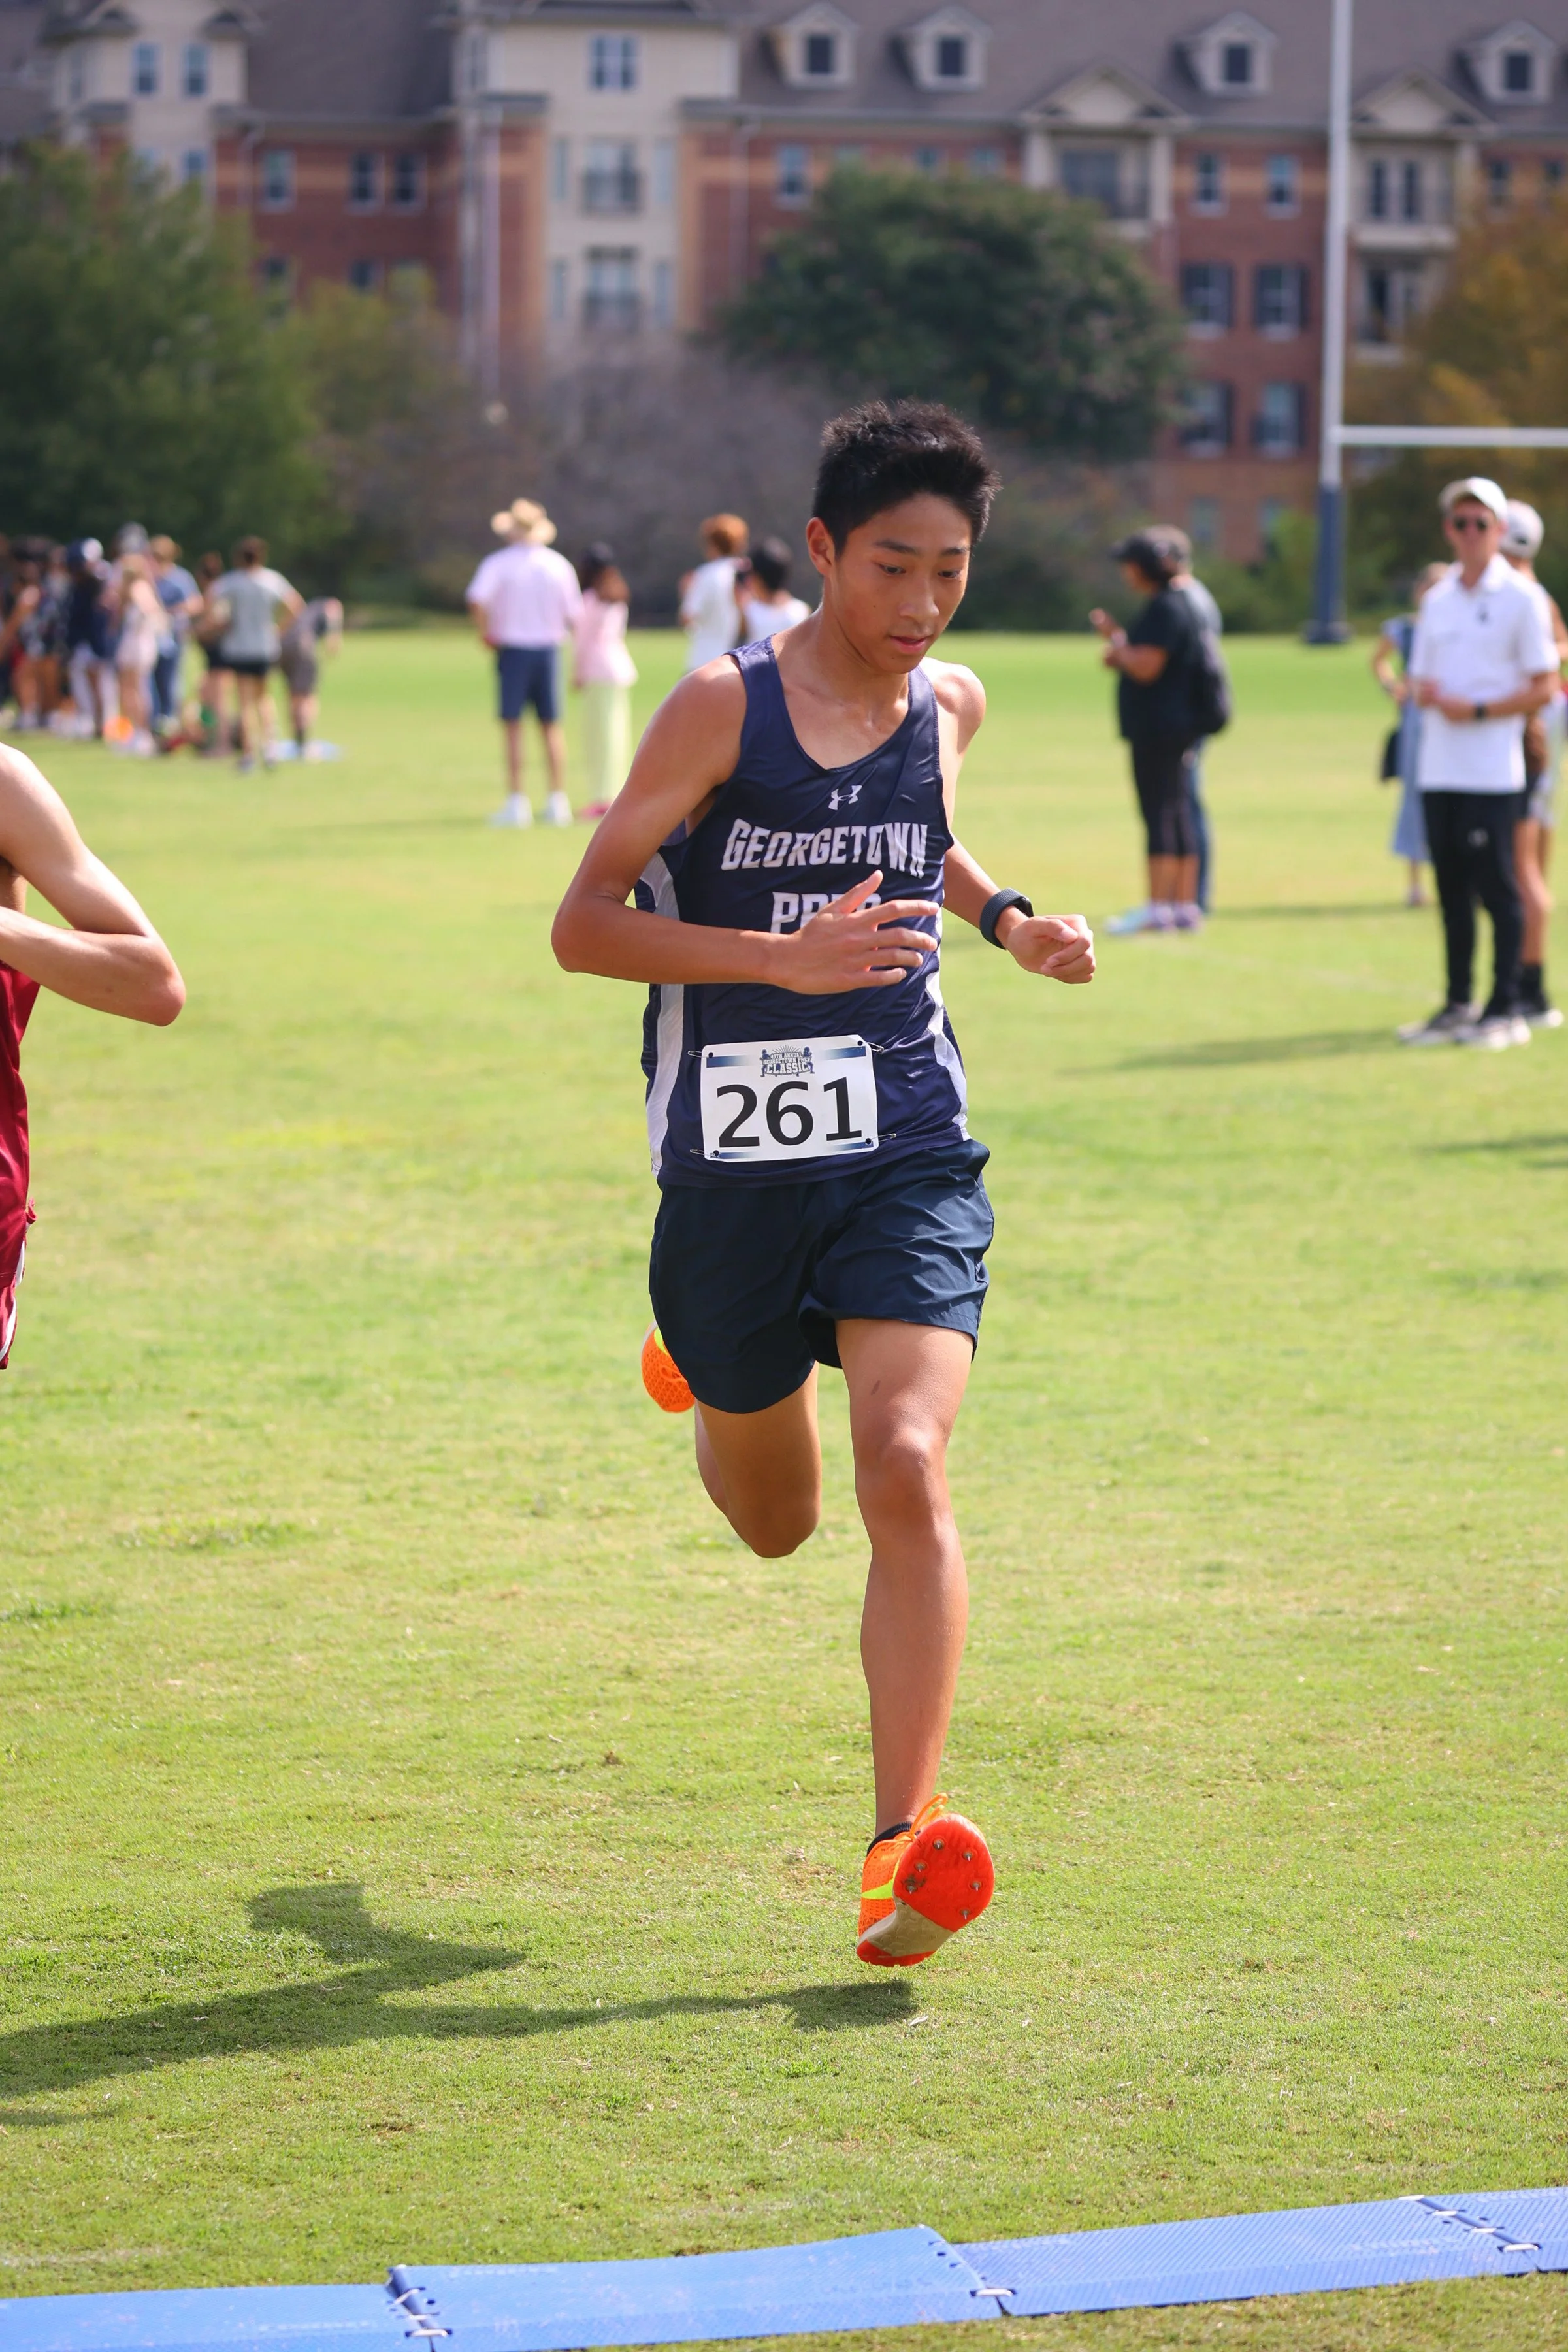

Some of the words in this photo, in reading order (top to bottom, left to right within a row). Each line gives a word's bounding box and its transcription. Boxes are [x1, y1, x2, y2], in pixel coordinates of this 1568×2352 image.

[721, 818, 928, 879] GEORGETOWN
[767, 1062, 809, 1073] CLASSIC
[716, 1077, 862, 1148] 261
